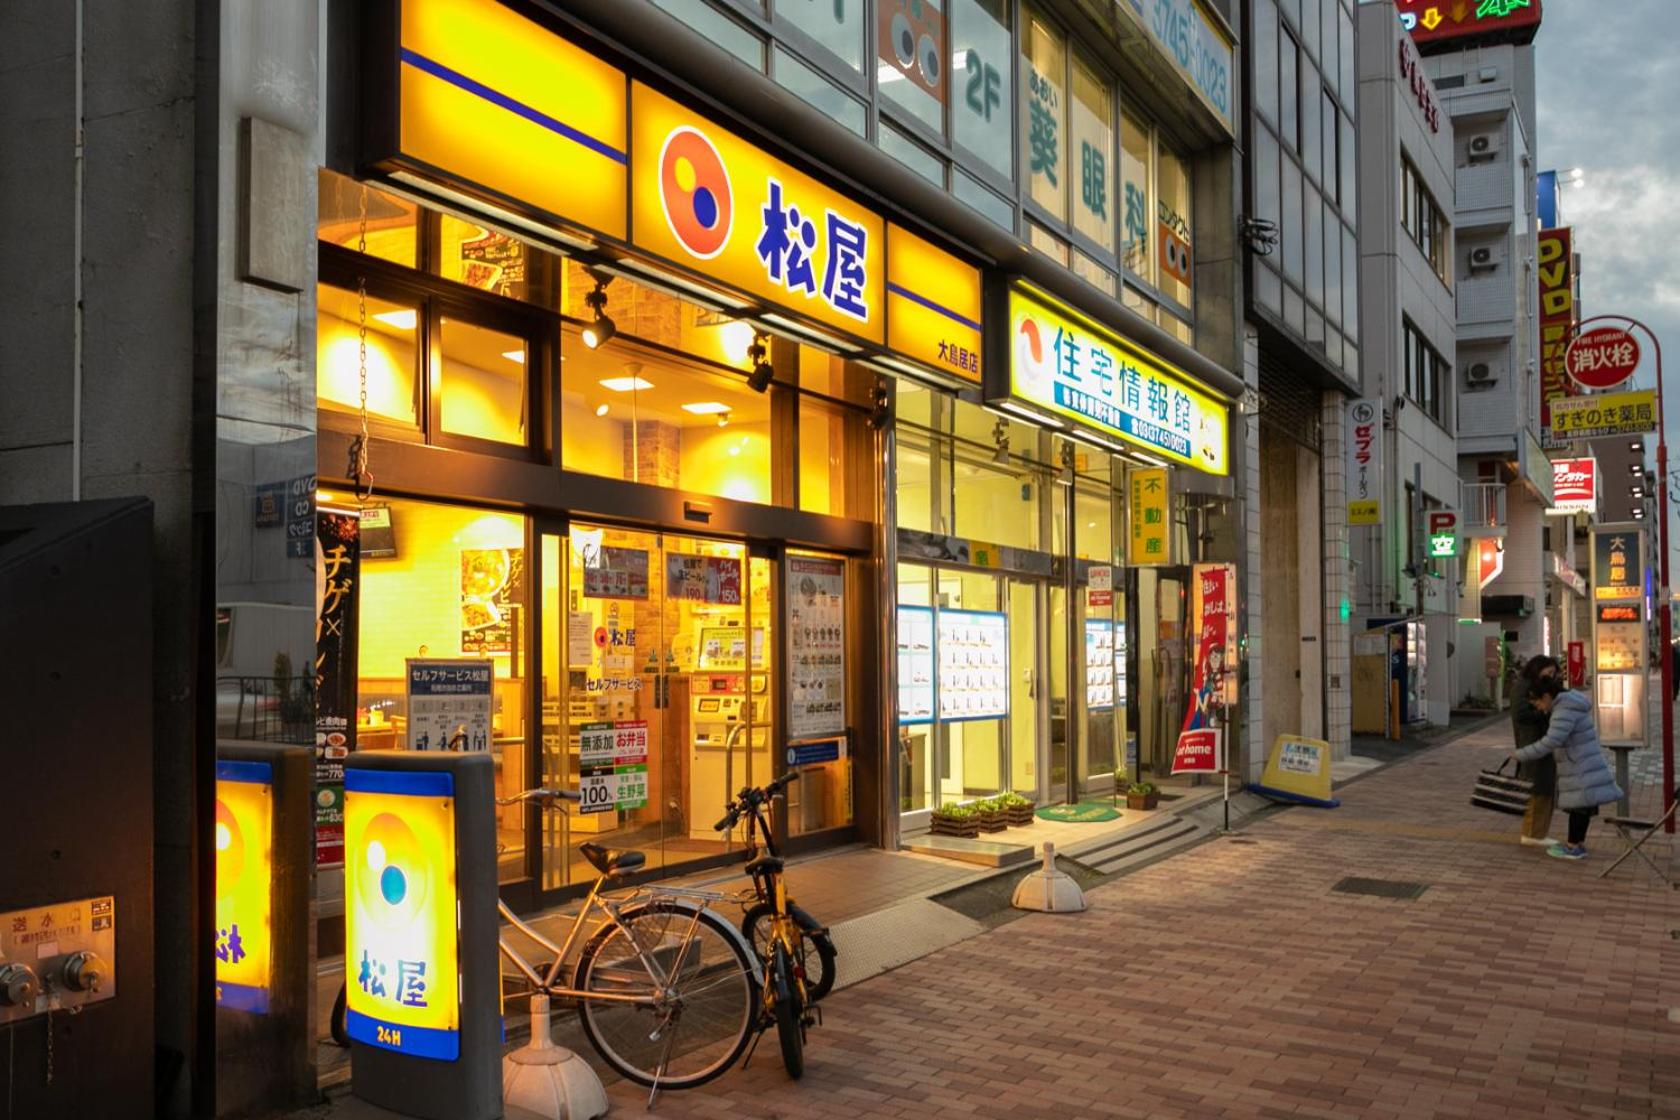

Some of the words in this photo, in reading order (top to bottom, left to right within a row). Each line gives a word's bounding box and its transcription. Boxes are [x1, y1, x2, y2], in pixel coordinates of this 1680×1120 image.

[965, 48, 1001, 123] 2F
[1029, 69, 1057, 109] あおい
[757, 178, 869, 322] 松屋
[1539, 238, 1571, 316] DVD
[1577, 335, 1592, 345] FIRE
[1593, 331, 1626, 344] HYDRANT
[1572, 342, 1634, 373] 消火栓
[1053, 326, 1191, 432] 住宅情報館
[1555, 403, 1651, 428] すぎのき薬局
[1355, 423, 1375, 464] ゼブラ
[1145, 477, 1162, 553] 不動産
[1430, 513, 1456, 534] P
[1431, 537, 1454, 556] 空
[610, 628, 636, 647] 松屋
[411, 668, 489, 682] セルフサービス松屋
[582, 734, 613, 752] 無添加
[616, 730, 646, 748] お弁当
[617, 784, 645, 800] 生野菜
[358, 950, 427, 1006] 松屋
[377, 1026, 402, 1046] 24H
